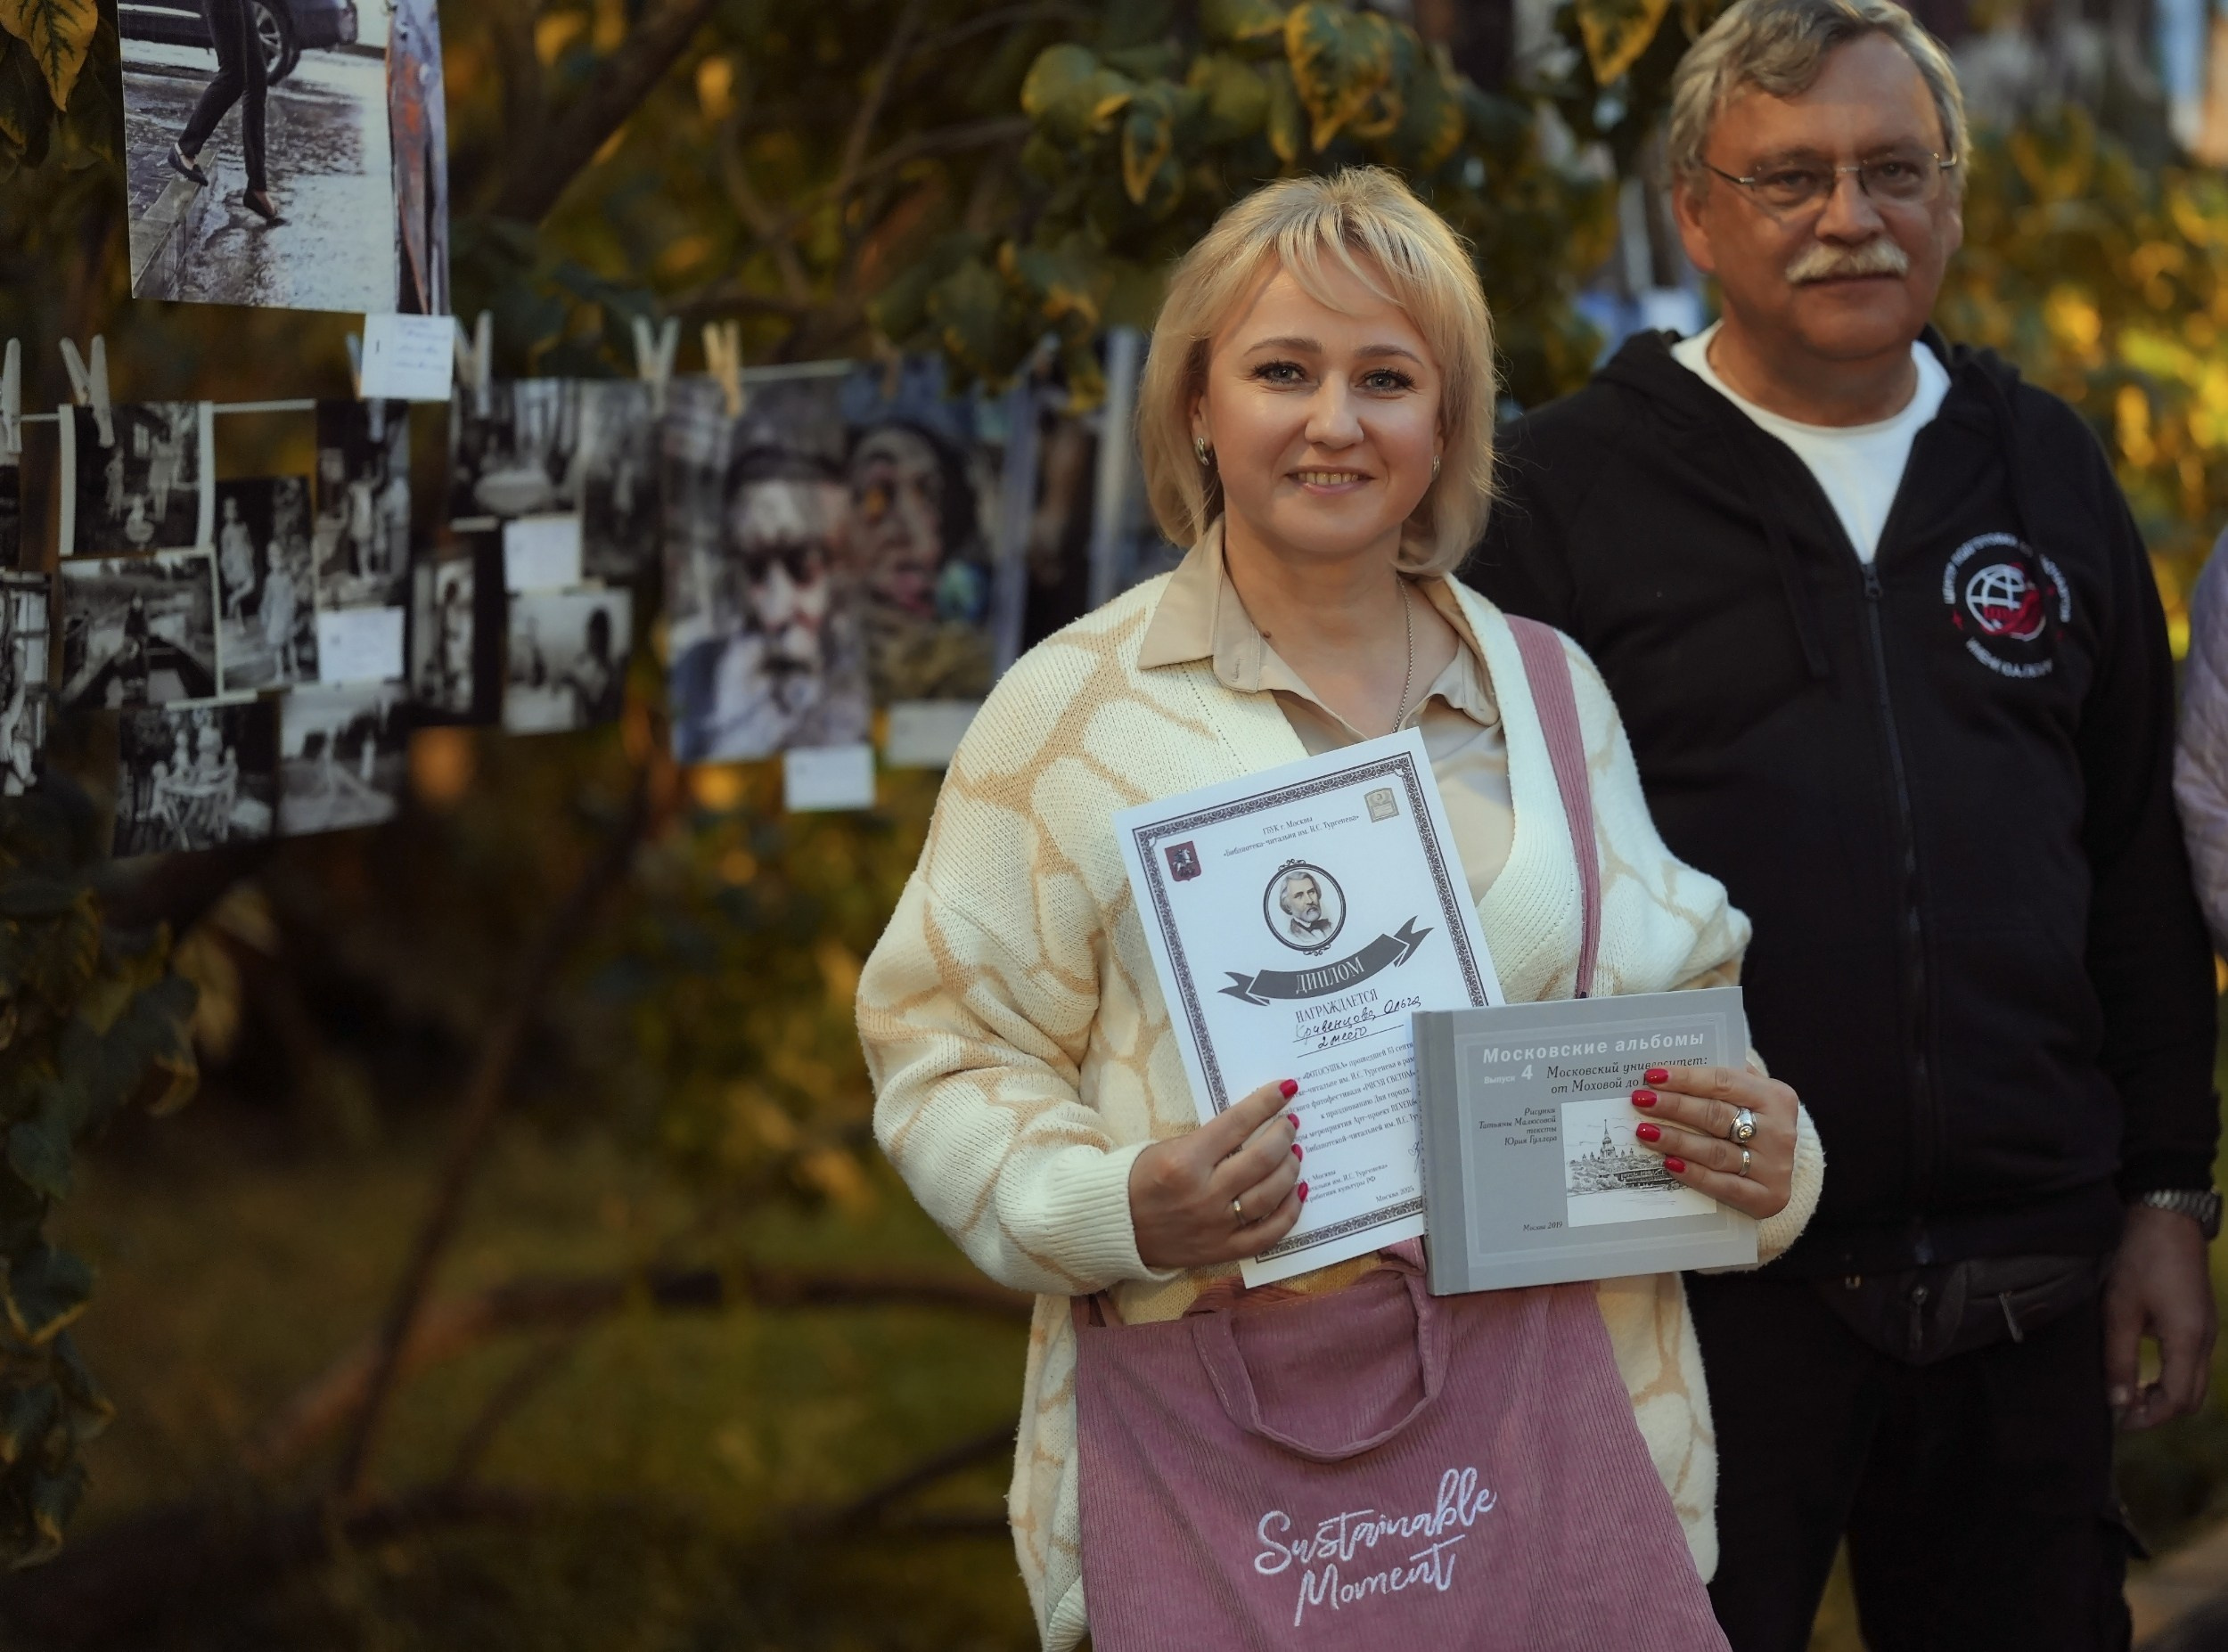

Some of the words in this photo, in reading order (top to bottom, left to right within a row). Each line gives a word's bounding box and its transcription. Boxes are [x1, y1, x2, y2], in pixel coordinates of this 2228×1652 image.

[1262, 824, 1280, 836] ГБУК
[1286, 816, 1313, 829] Москвы
[1295, 956, 1364, 994] ДИПЛОМ
[1295, 988, 1378, 1023] НАГРАЖДАЕТСЯ
[1383, 995, 1421, 1015] Ольга
[1318, 1035, 1329, 1049] 2
[1482, 1041, 1608, 1064] Московские
[1615, 1033, 1704, 1052] альбомы
[1364, 1062, 1397, 1078] Тургенева
[1484, 1075, 1516, 1085] Выпуск
[1520, 1064, 1534, 1081] 4
[1546, 1061, 1619, 1079] Московский
[1551, 1084, 1569, 1094] от
[1570, 1076, 1623, 1092] Моховой
[1625, 1078, 1639, 1088] до
[1311, 1087, 1362, 1108] фотофестиваля
[1325, 1099, 1373, 1118] празднованию
[1374, 1094, 1387, 1103] Дня
[1388, 1087, 1412, 1099] города.
[1524, 1107, 1556, 1116] Рисунки
[1309, 1119, 1353, 1138] мероприятия
[1479, 1120, 1512, 1130] Татьяны
[1504, 1136, 1528, 1147] Юрия
[1375, 1190, 1399, 1203] Москва
[1522, 1223, 1546, 1231] Москва
[1254, 1466, 1498, 1575] Sustainable
[1294, 1533, 1466, 1628] Moment
